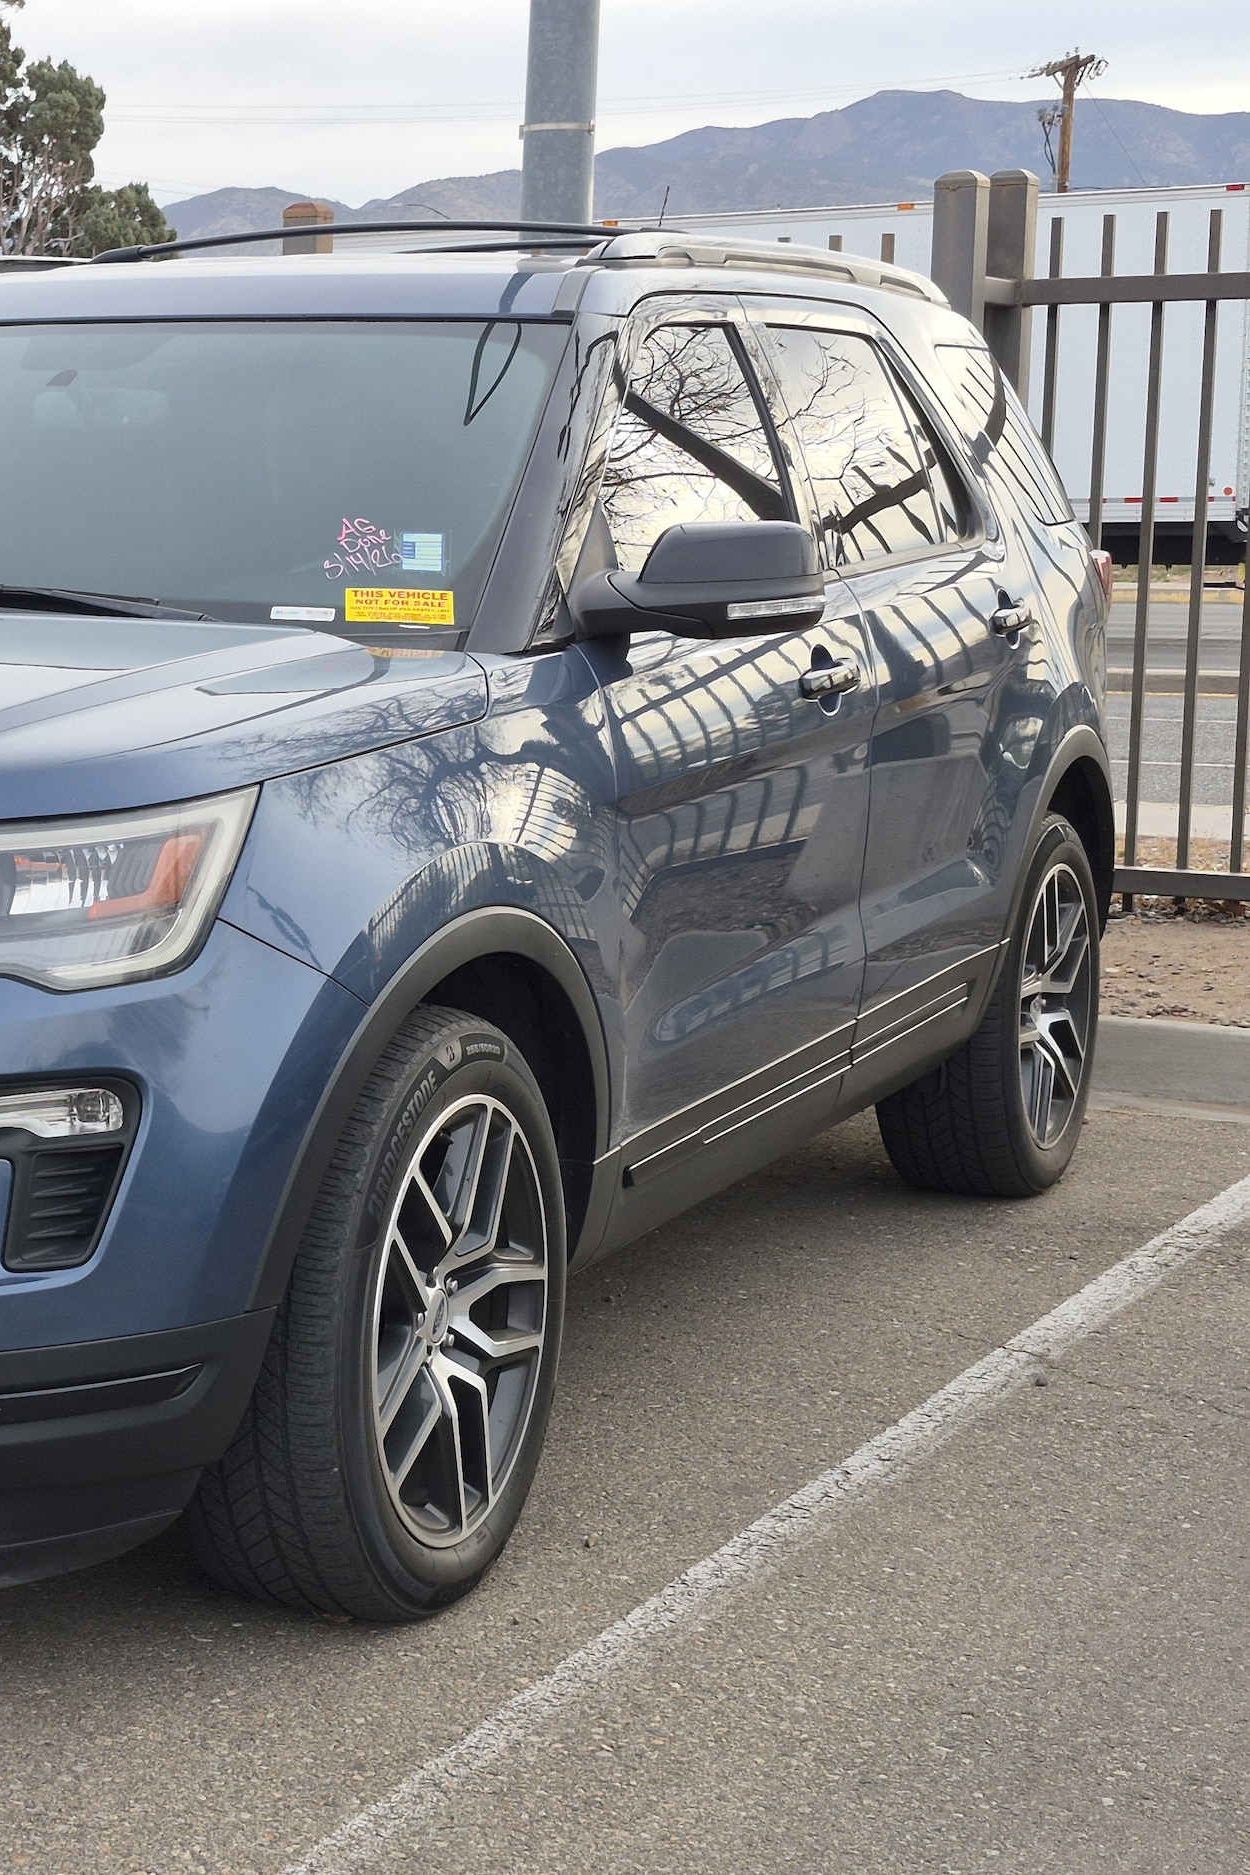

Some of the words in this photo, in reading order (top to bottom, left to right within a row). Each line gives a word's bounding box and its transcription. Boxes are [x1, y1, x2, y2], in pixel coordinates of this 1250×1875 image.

[339, 529, 392, 553] Done
[351, 589, 384, 598] THIS
[388, 590, 449, 601] VEHICLE
[413, 600, 446, 608] SALE
[367, 1069, 438, 1223] BRIDGESTONE
